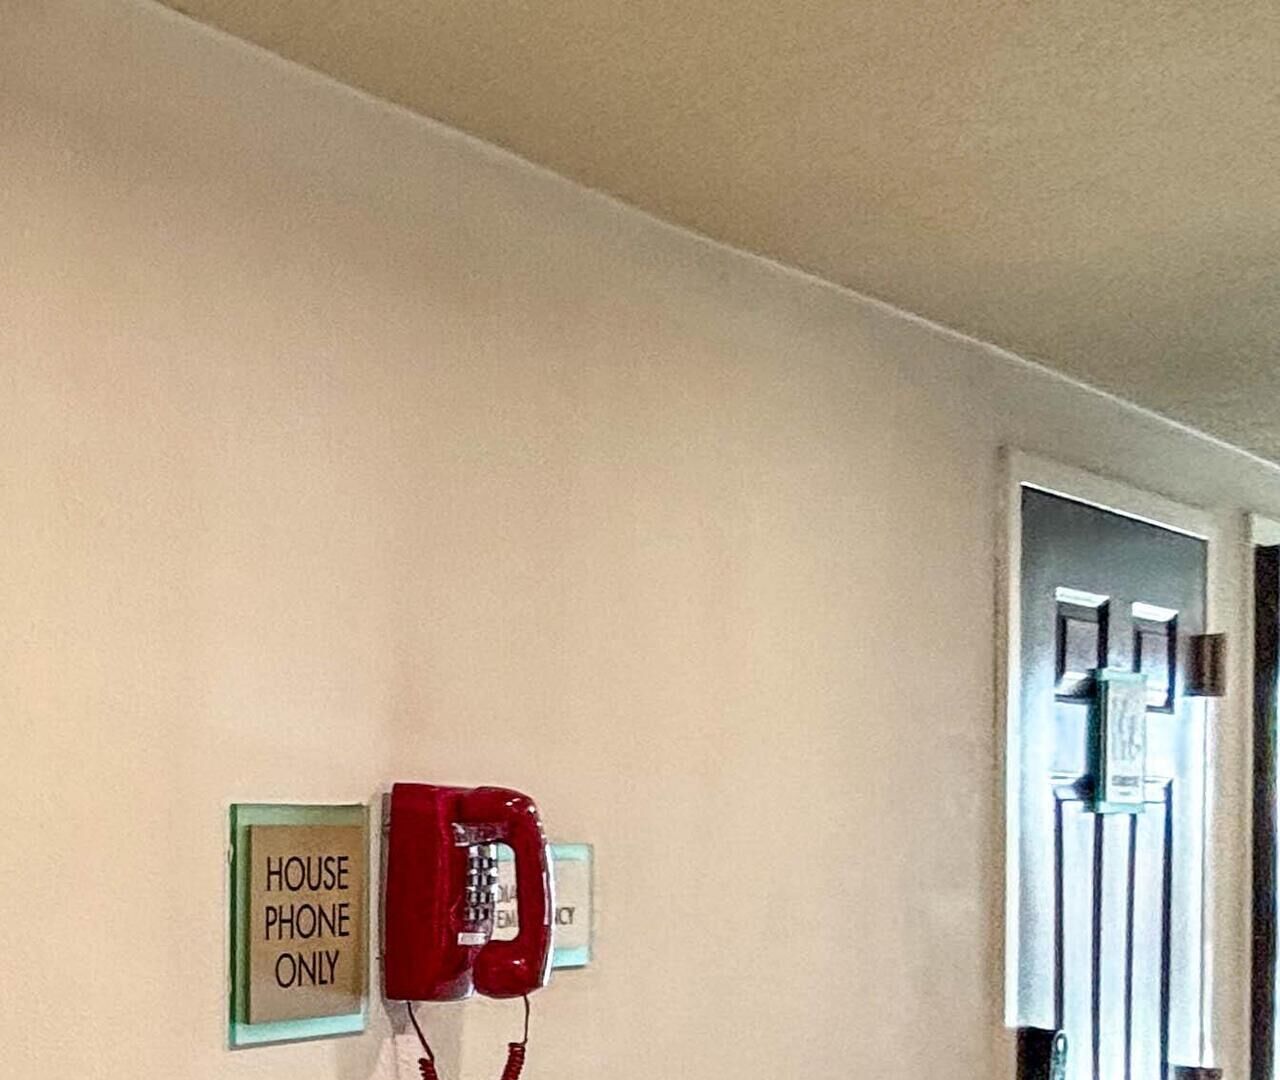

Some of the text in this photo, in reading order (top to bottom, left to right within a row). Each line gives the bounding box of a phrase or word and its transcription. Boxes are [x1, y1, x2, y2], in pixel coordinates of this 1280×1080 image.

[266, 855, 349, 892] HOUSE
[264, 903, 350, 940] PHONE
[275, 950, 340, 988] ONLY
